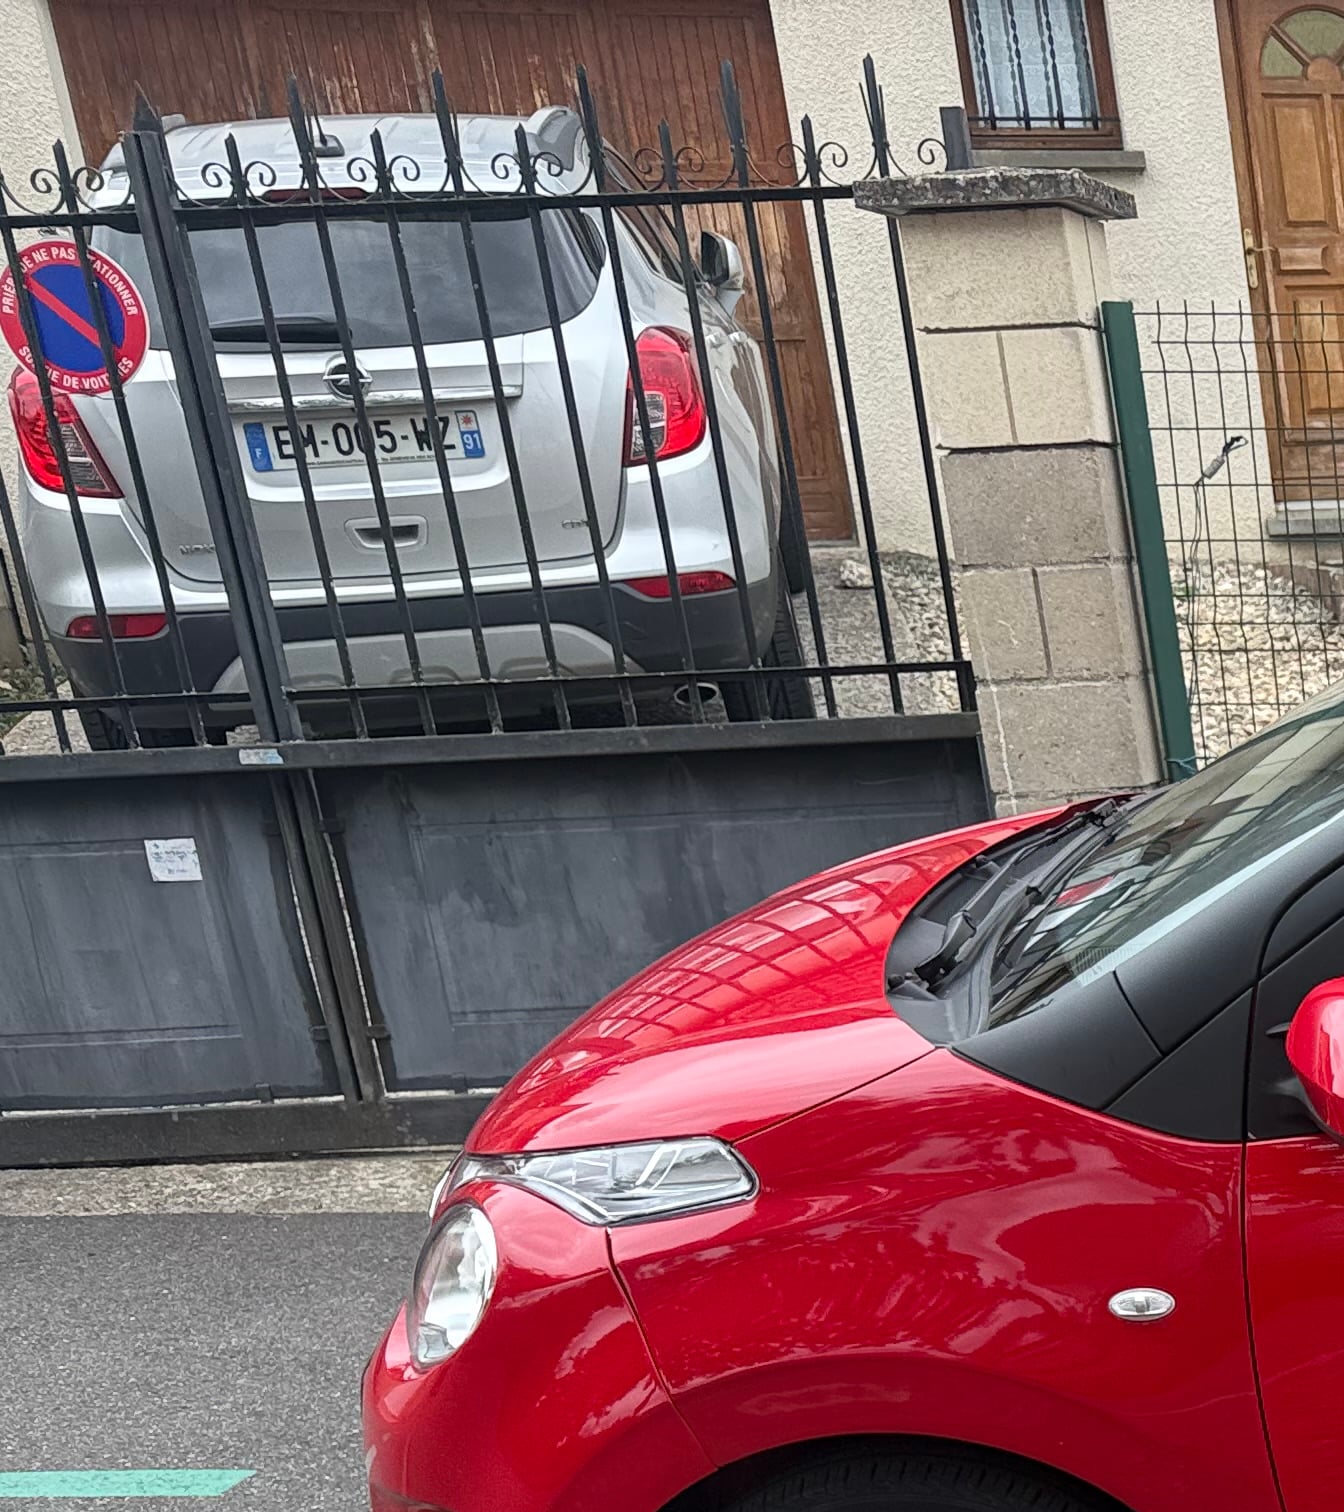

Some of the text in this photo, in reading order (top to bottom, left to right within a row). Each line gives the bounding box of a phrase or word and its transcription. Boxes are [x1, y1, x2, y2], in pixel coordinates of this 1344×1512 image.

[32, 248, 50, 264] NE
[51, 246, 77, 261] PAS
[62, 374, 80, 390] DE
[462, 432, 482, 451] 91
